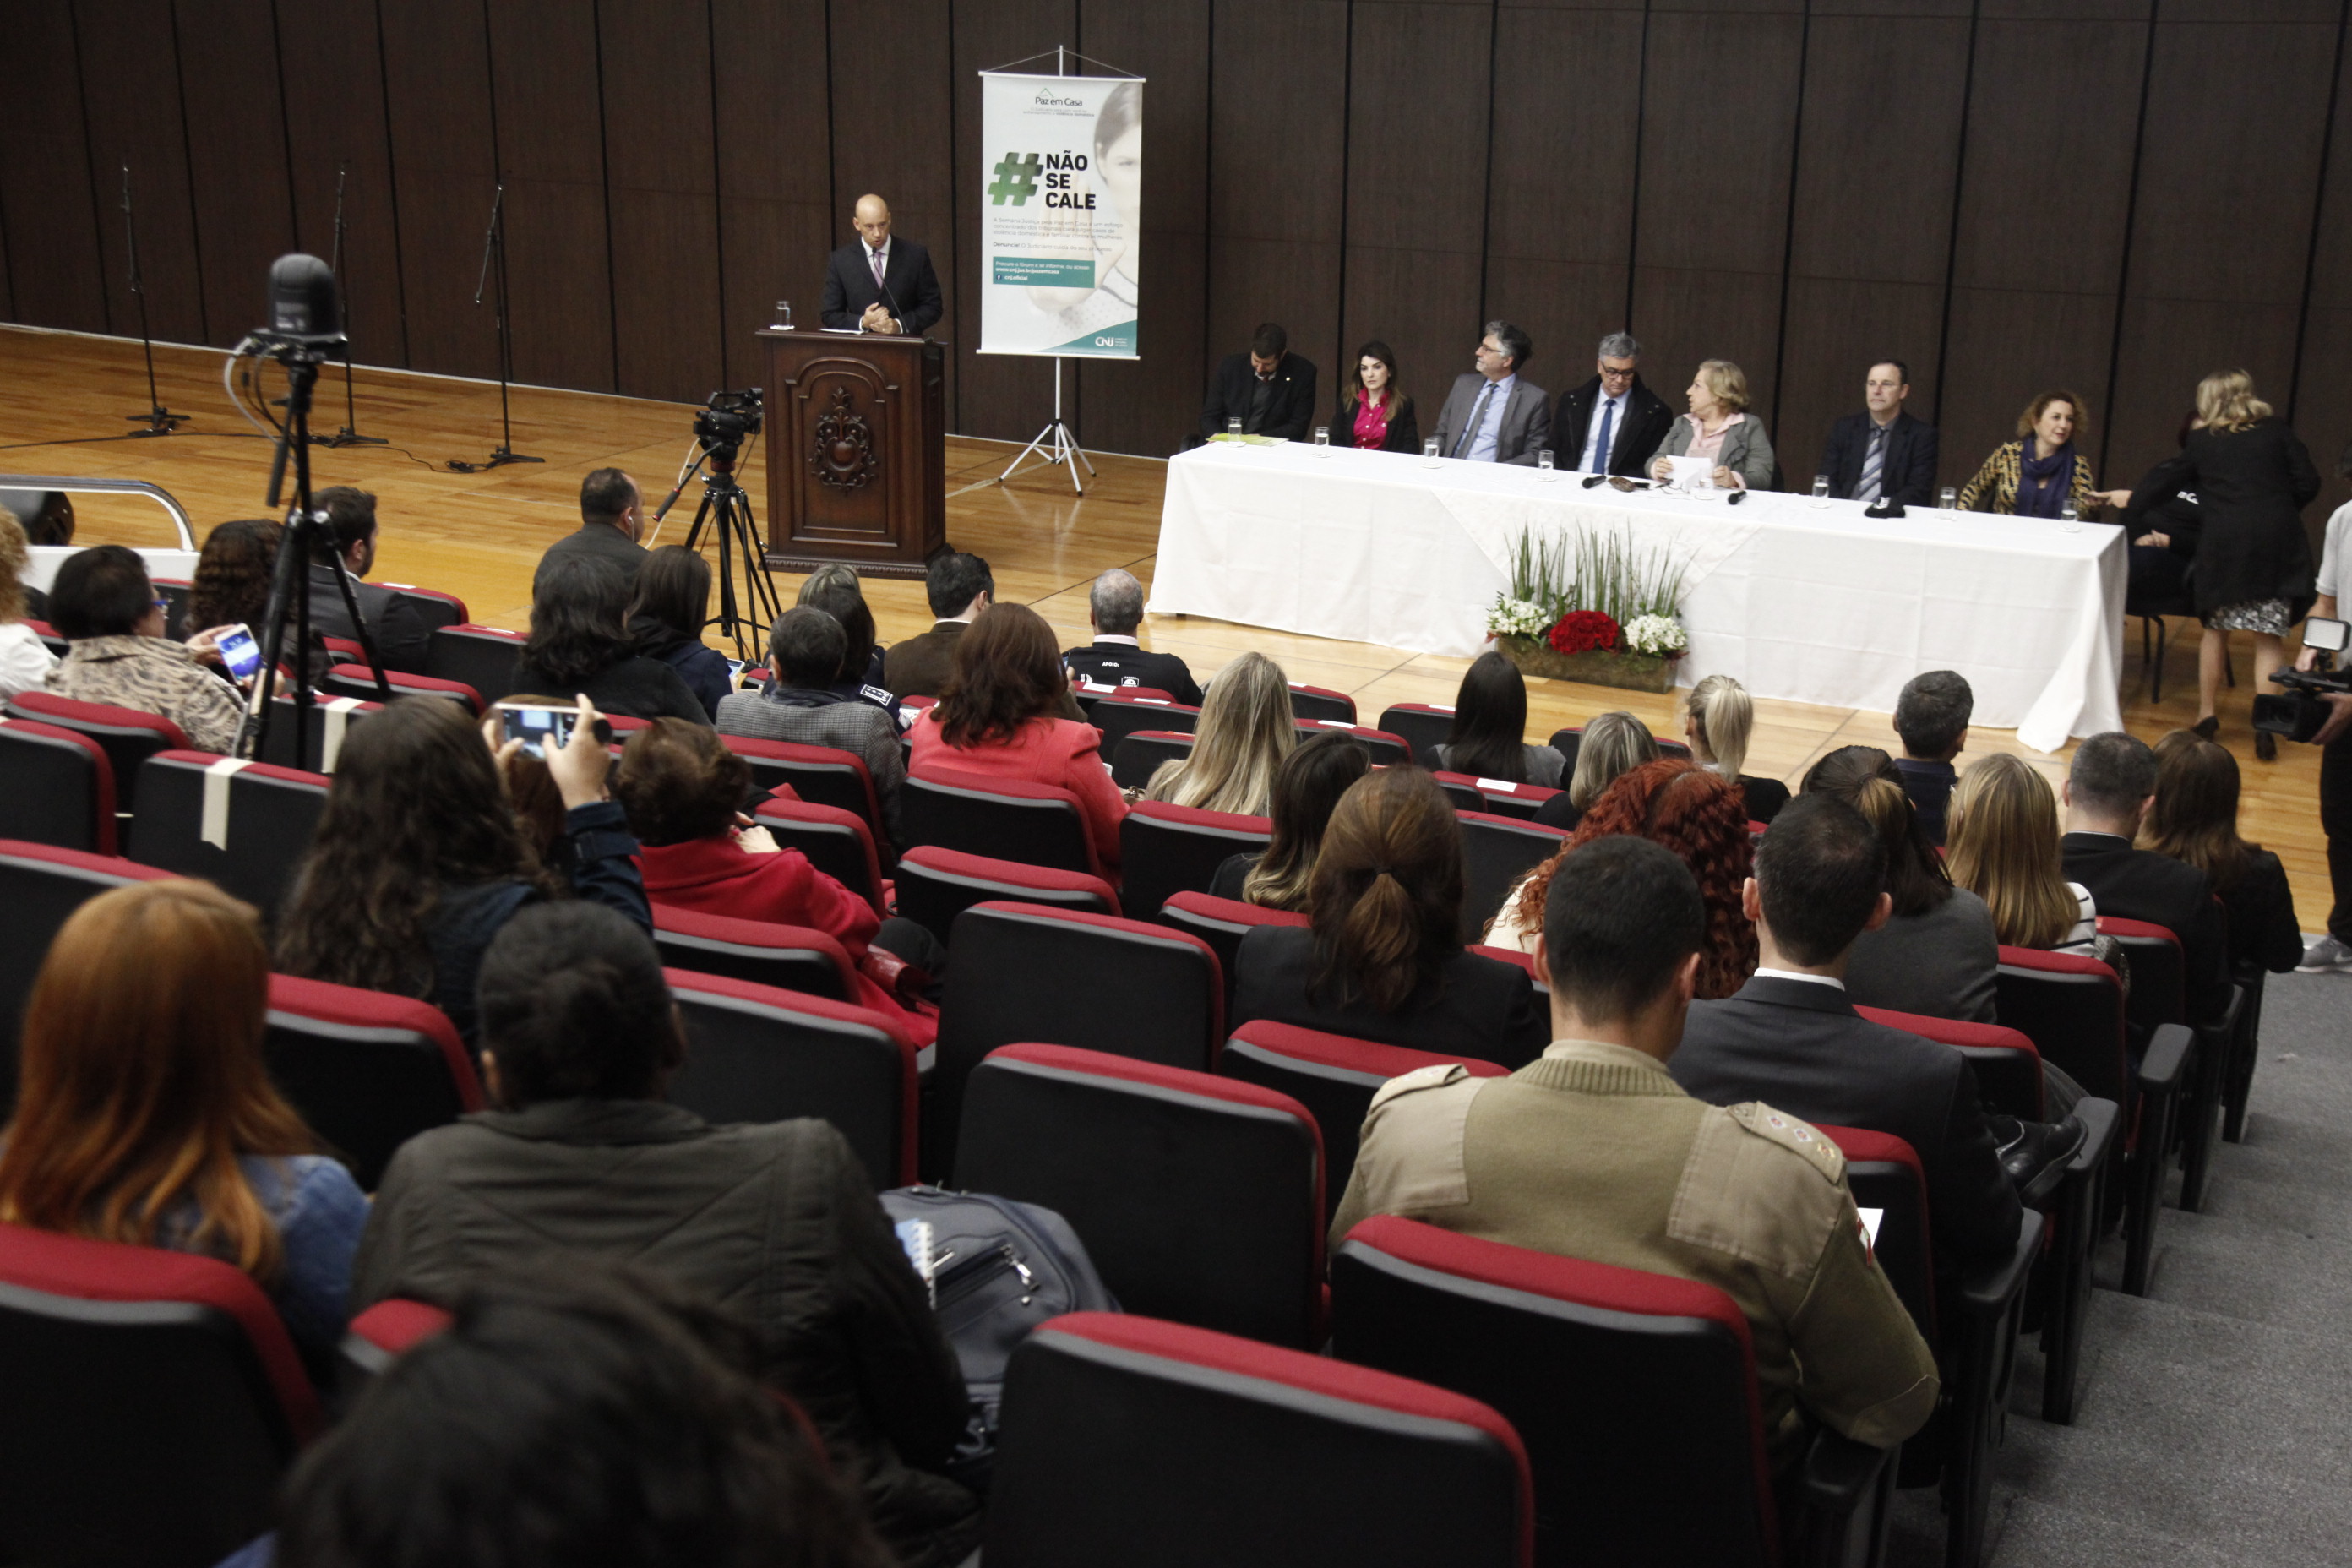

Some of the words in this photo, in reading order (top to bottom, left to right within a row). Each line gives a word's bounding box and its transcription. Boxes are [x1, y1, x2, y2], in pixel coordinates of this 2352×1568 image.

[1035, 96, 1049, 106] Paz
[1064, 97, 1082, 106] Casa
[1046, 150, 1088, 172] NÃO
[1046, 173, 1070, 189] SE
[1045, 192, 1096, 210] CALE
[1095, 336, 1114, 347] CNJ
